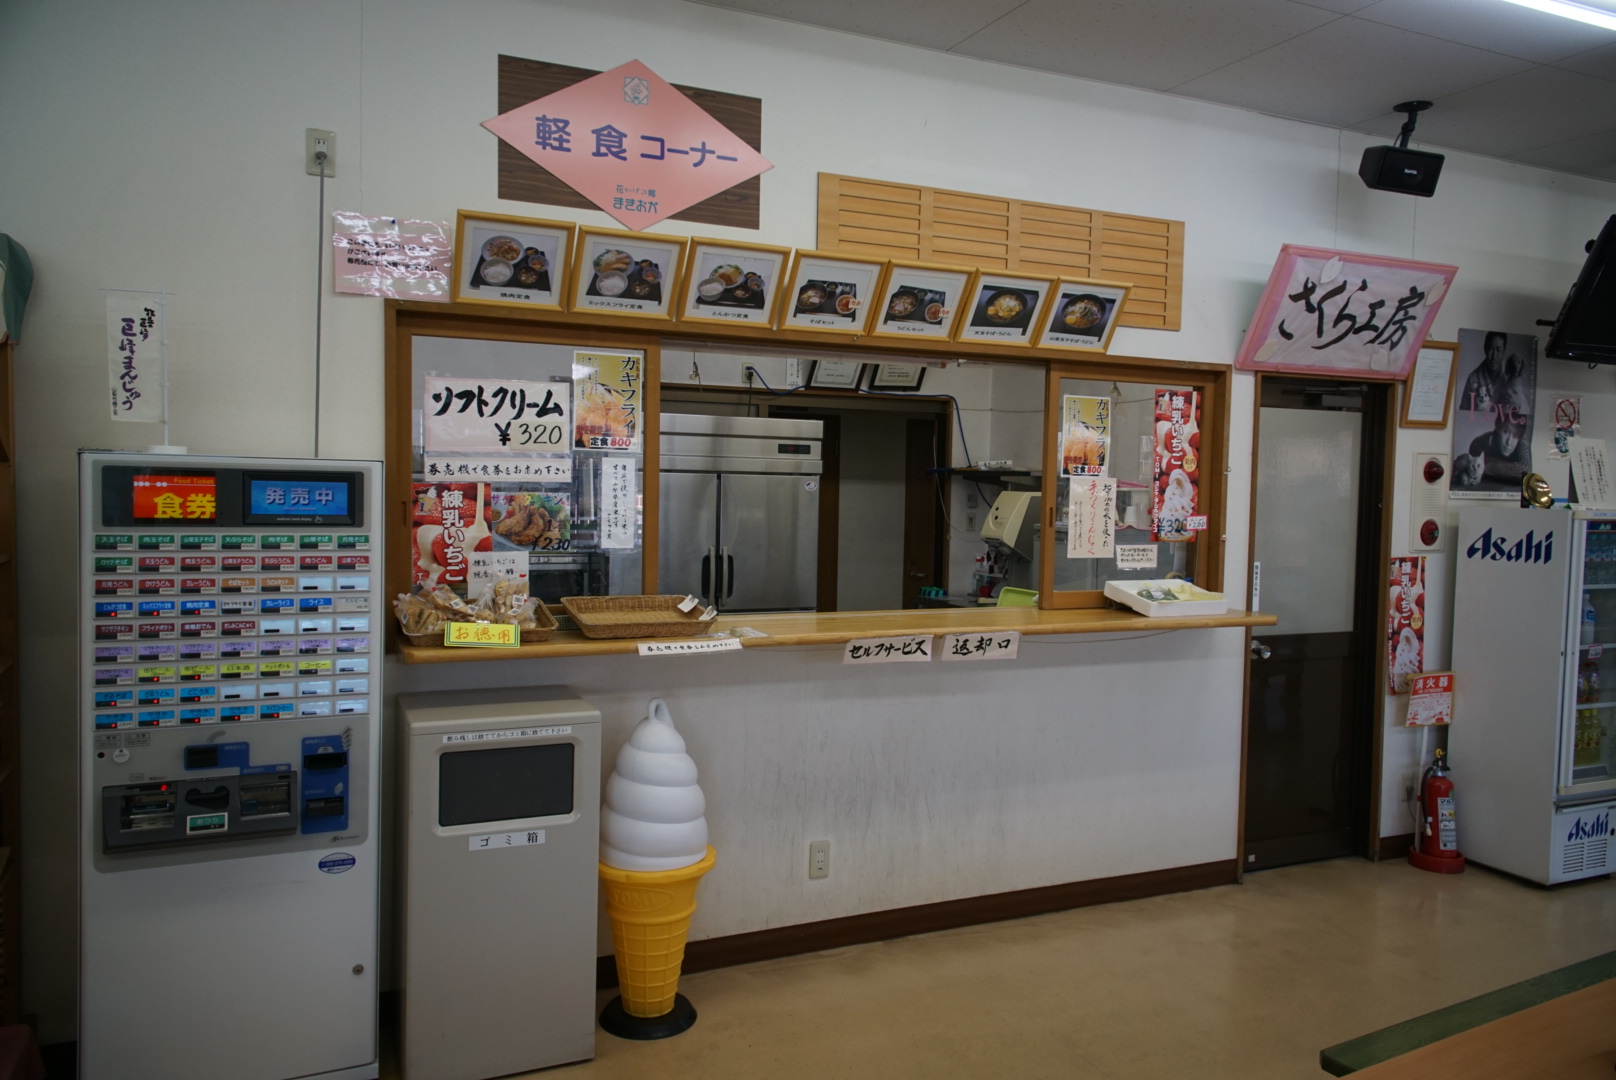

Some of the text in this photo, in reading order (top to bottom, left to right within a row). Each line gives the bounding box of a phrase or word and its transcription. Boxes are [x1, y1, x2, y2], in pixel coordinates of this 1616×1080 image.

[535, 114, 738, 167] 軽食コーナー
[613, 197, 659, 214] まきおか
[500, 292, 530, 300] 焼肉定食
[588, 300, 643, 310] ミックスフライ定食
[711, 311, 748, 319] とんかつ定食
[1278, 276, 1425, 352] さくら工房
[432, 384, 563, 420] ソフトクリーム
[620, 356, 638, 435] カキフライ
[1468, 392, 1520, 425] Love
[494, 421, 563, 446] ¥320
[1095, 399, 1109, 464] カキフライ
[1171, 395, 1185, 465] 練乳いちご
[428, 463, 570, 476] 券売機で食券をお求め下さい
[153, 492, 216, 519] 食券
[265, 487, 334, 506] 発売中
[441, 490, 465, 582] 練乳いちご
[531, 534, 571, 551] ¥230
[1466, 527, 1553, 565] Asahi
[472, 558, 516, 568] 練乳いちごは
[1401, 561, 1412, 624] 練乳いちご
[454, 625, 511, 644] お徳用
[848, 637, 928, 659] セルフサービス
[952, 636, 1011, 656] 返却口
[187, 688, 210, 696] ところ天
[1415, 676, 1449, 690] 消火器
[447, 727, 568, 743] 飲み残しは捨ててからゴミ箱に捨てて下さい
[196, 817, 220, 825] おつり
[1567, 811, 1609, 842] Asahi
[480, 832, 538, 848] ゴミ箱
[614, 889, 656, 906] TOMI
